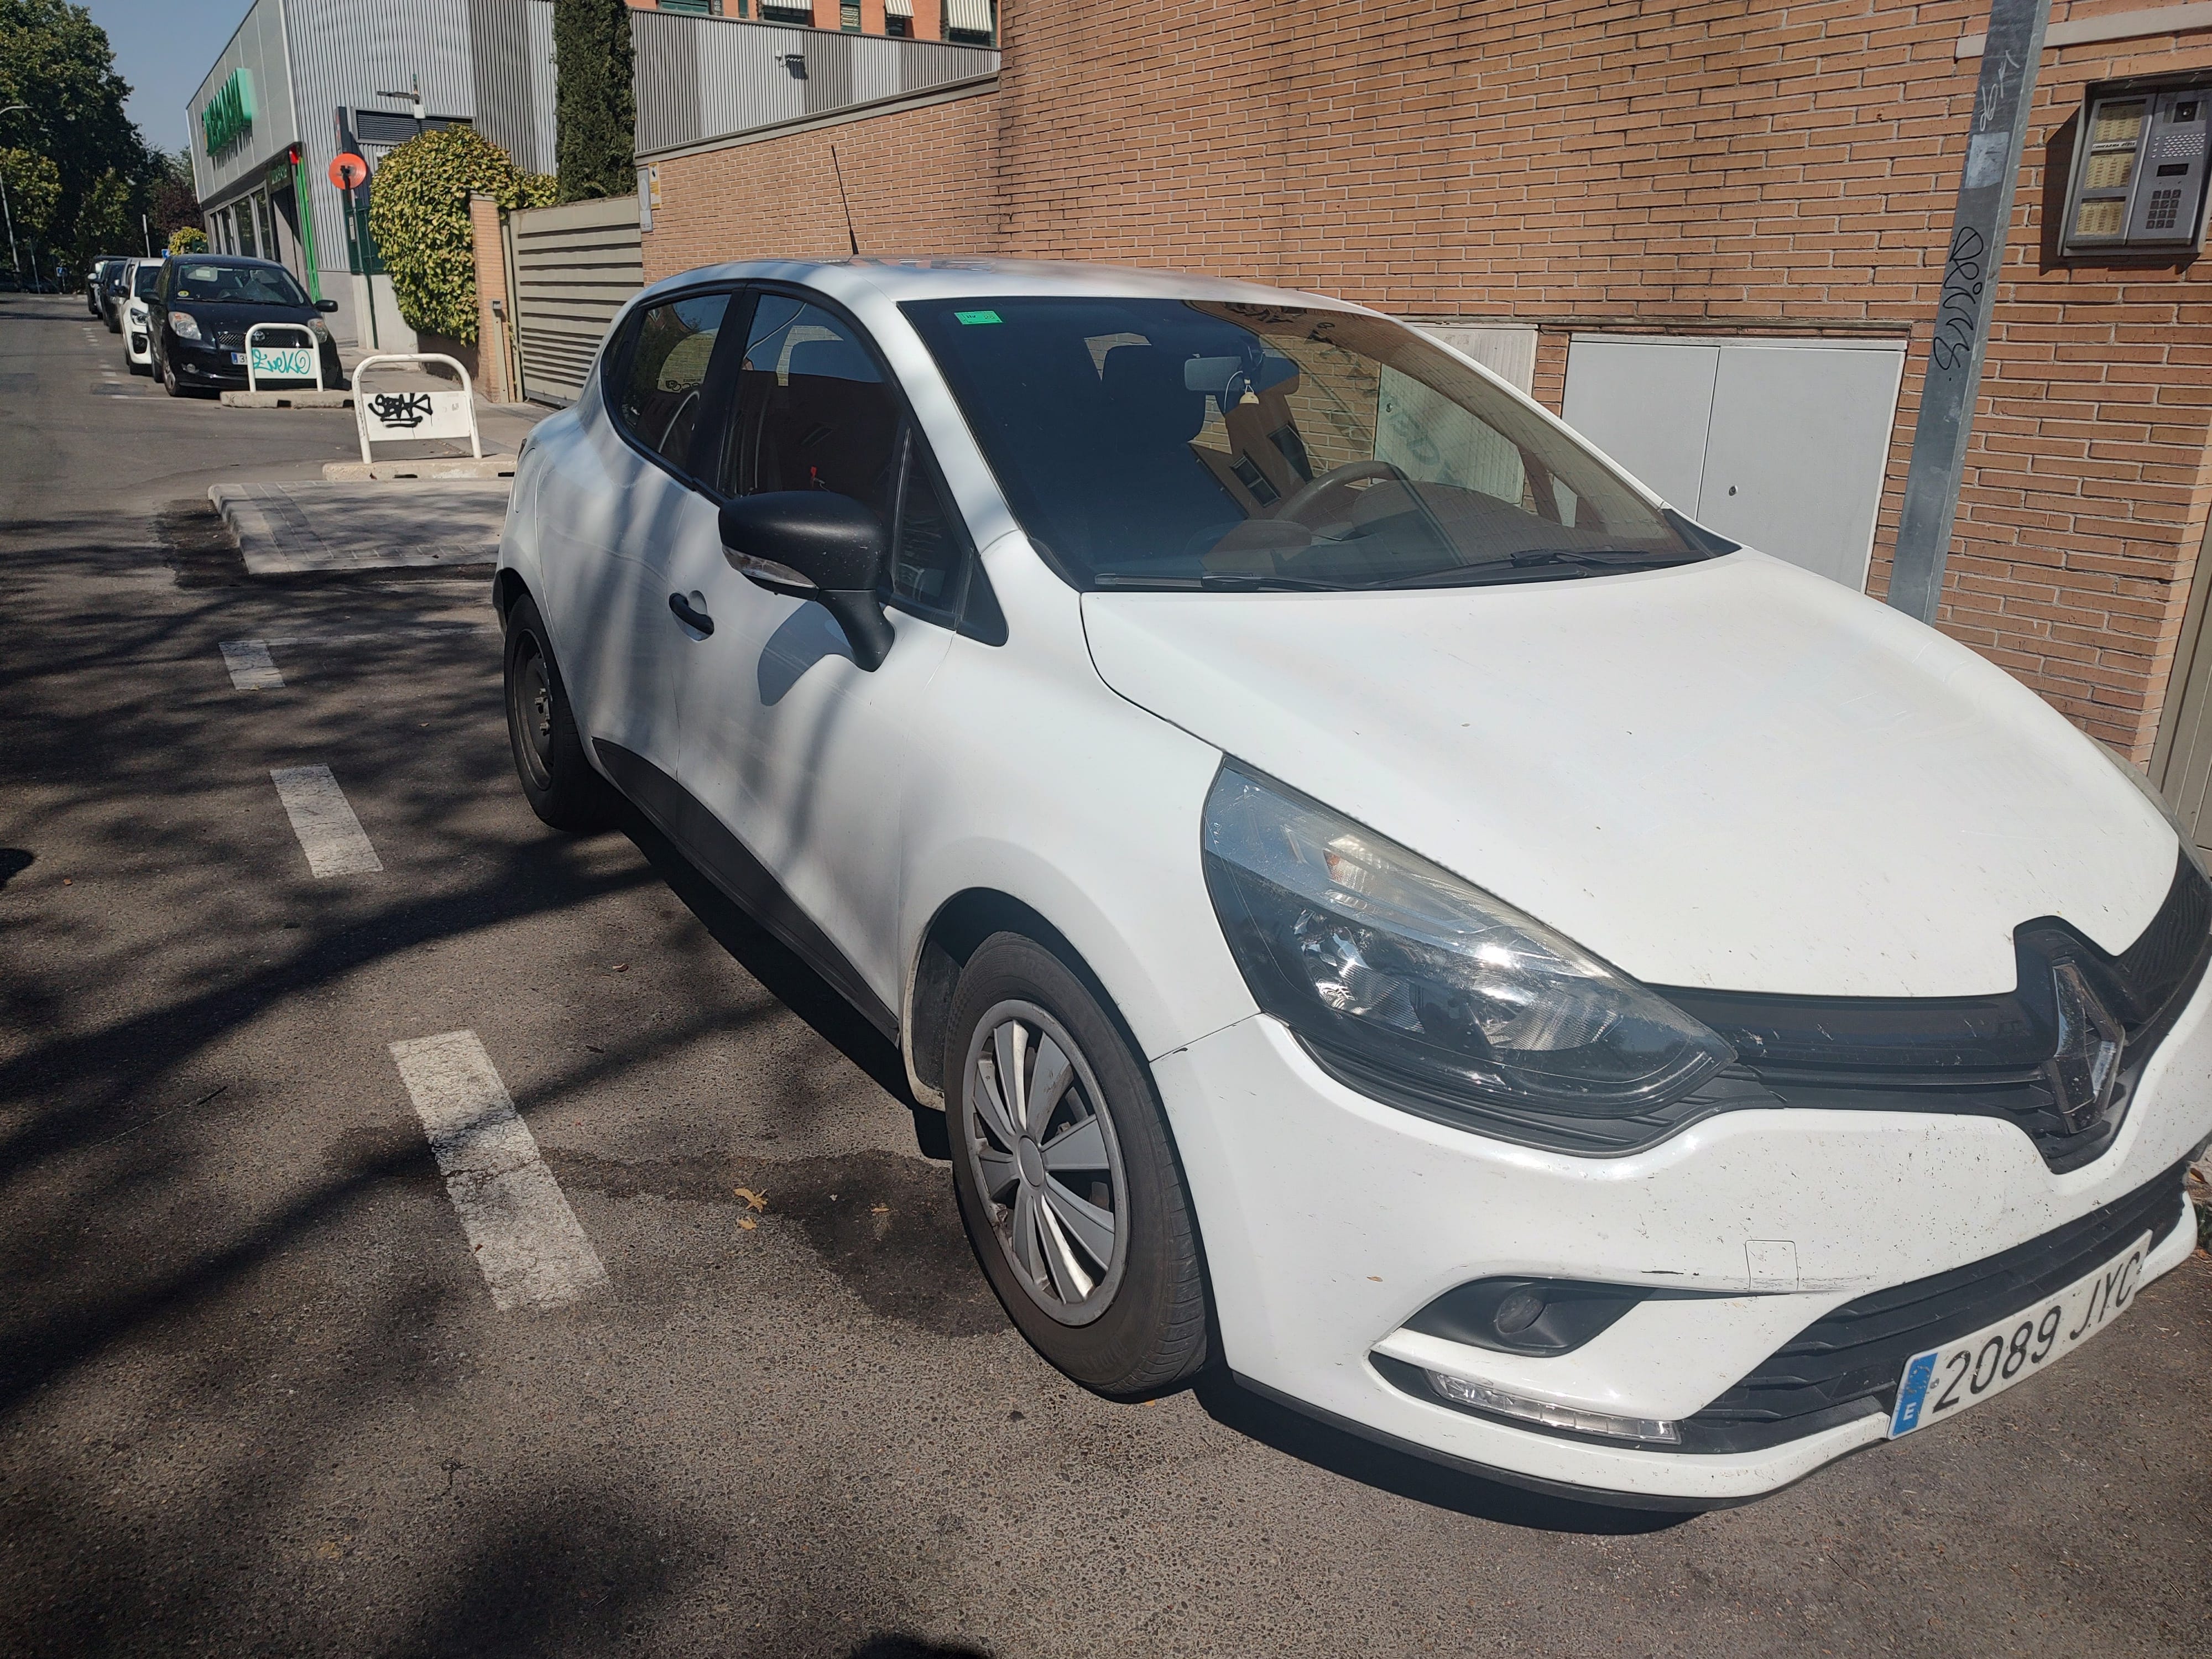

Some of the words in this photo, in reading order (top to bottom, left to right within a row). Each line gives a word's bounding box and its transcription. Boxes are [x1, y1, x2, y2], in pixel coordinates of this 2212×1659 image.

[1932, 1306, 2062, 1414] 2089
[2069, 1251, 2141, 1340] JYC
[1903, 1402, 1917, 1421] E
